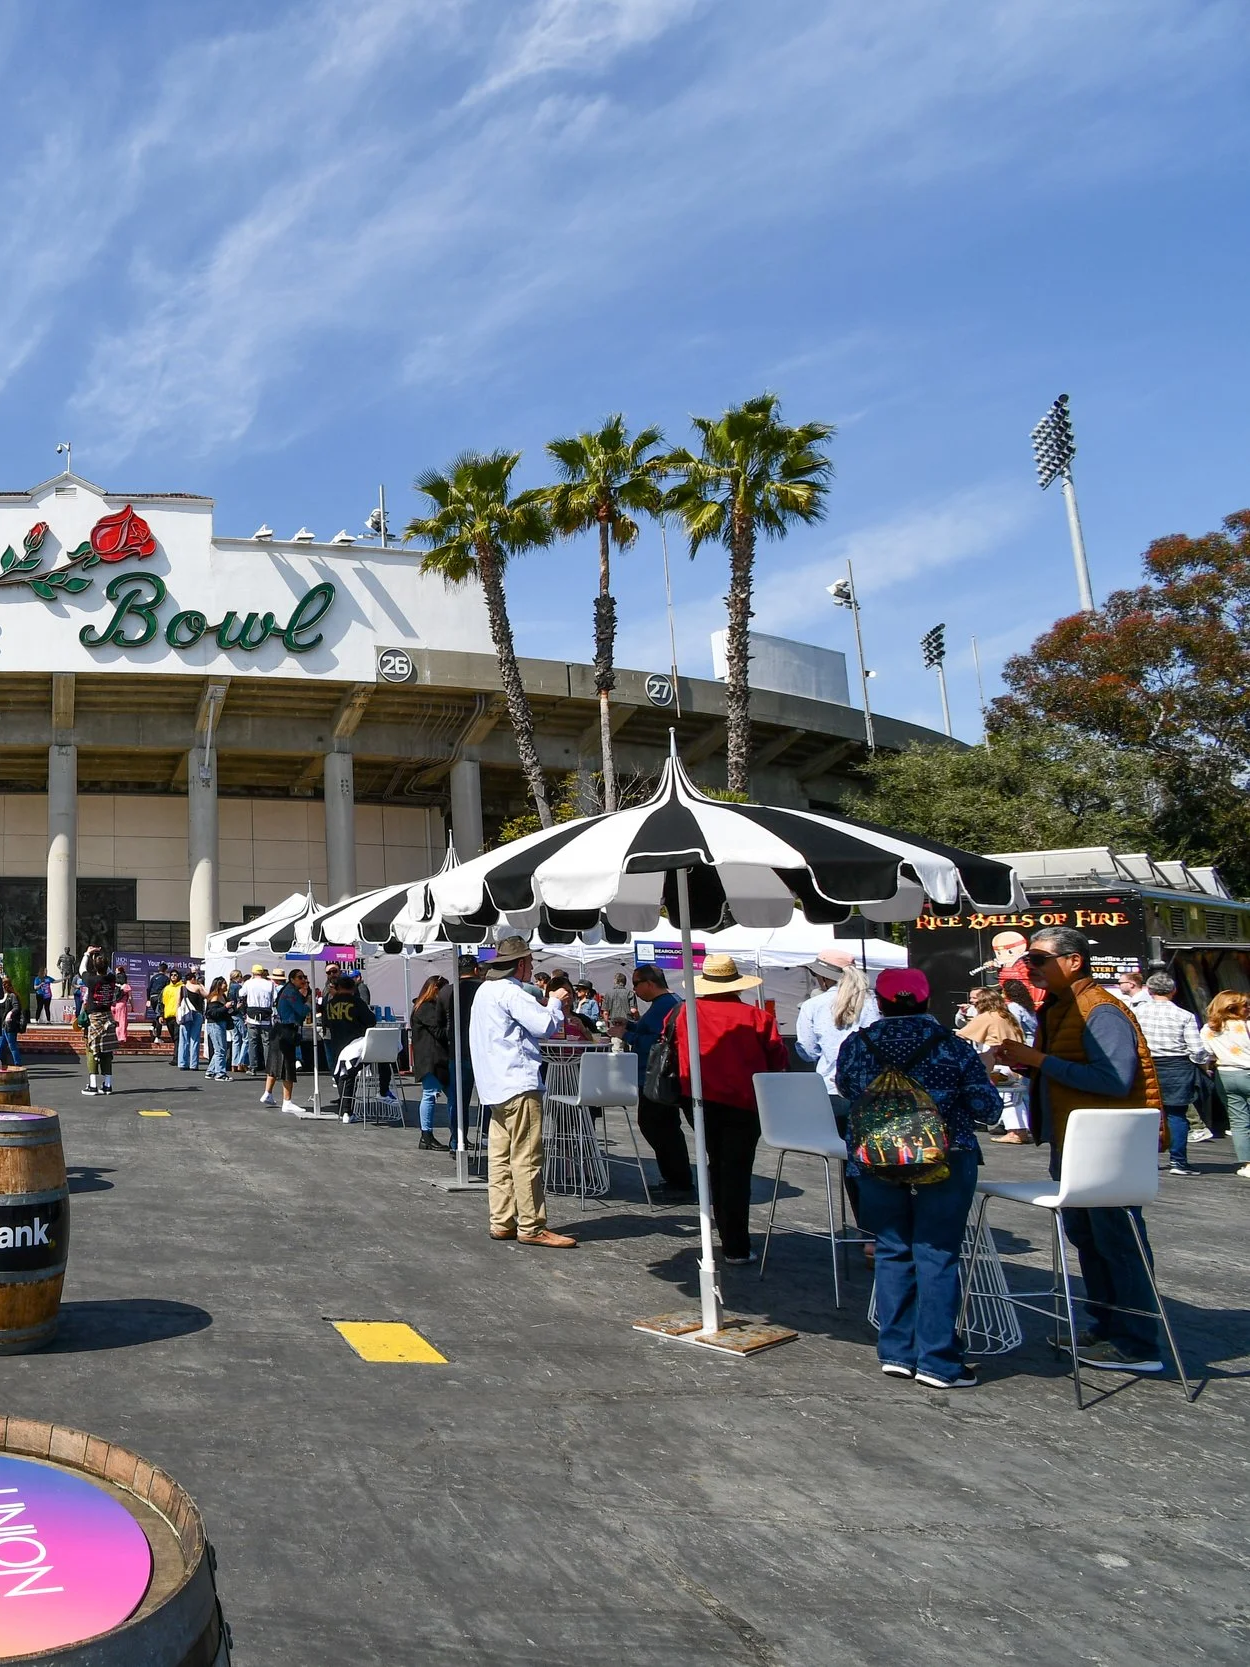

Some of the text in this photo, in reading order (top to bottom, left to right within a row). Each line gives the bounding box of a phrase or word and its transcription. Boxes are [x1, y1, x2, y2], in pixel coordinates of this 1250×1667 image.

[79, 572, 336, 653] Bowl
[382, 655, 408, 675] 26
[648, 680, 669, 699] 27
[915, 909, 1130, 931] RICE BALLS OF FIRE
[147, 959, 160, 967] Your
